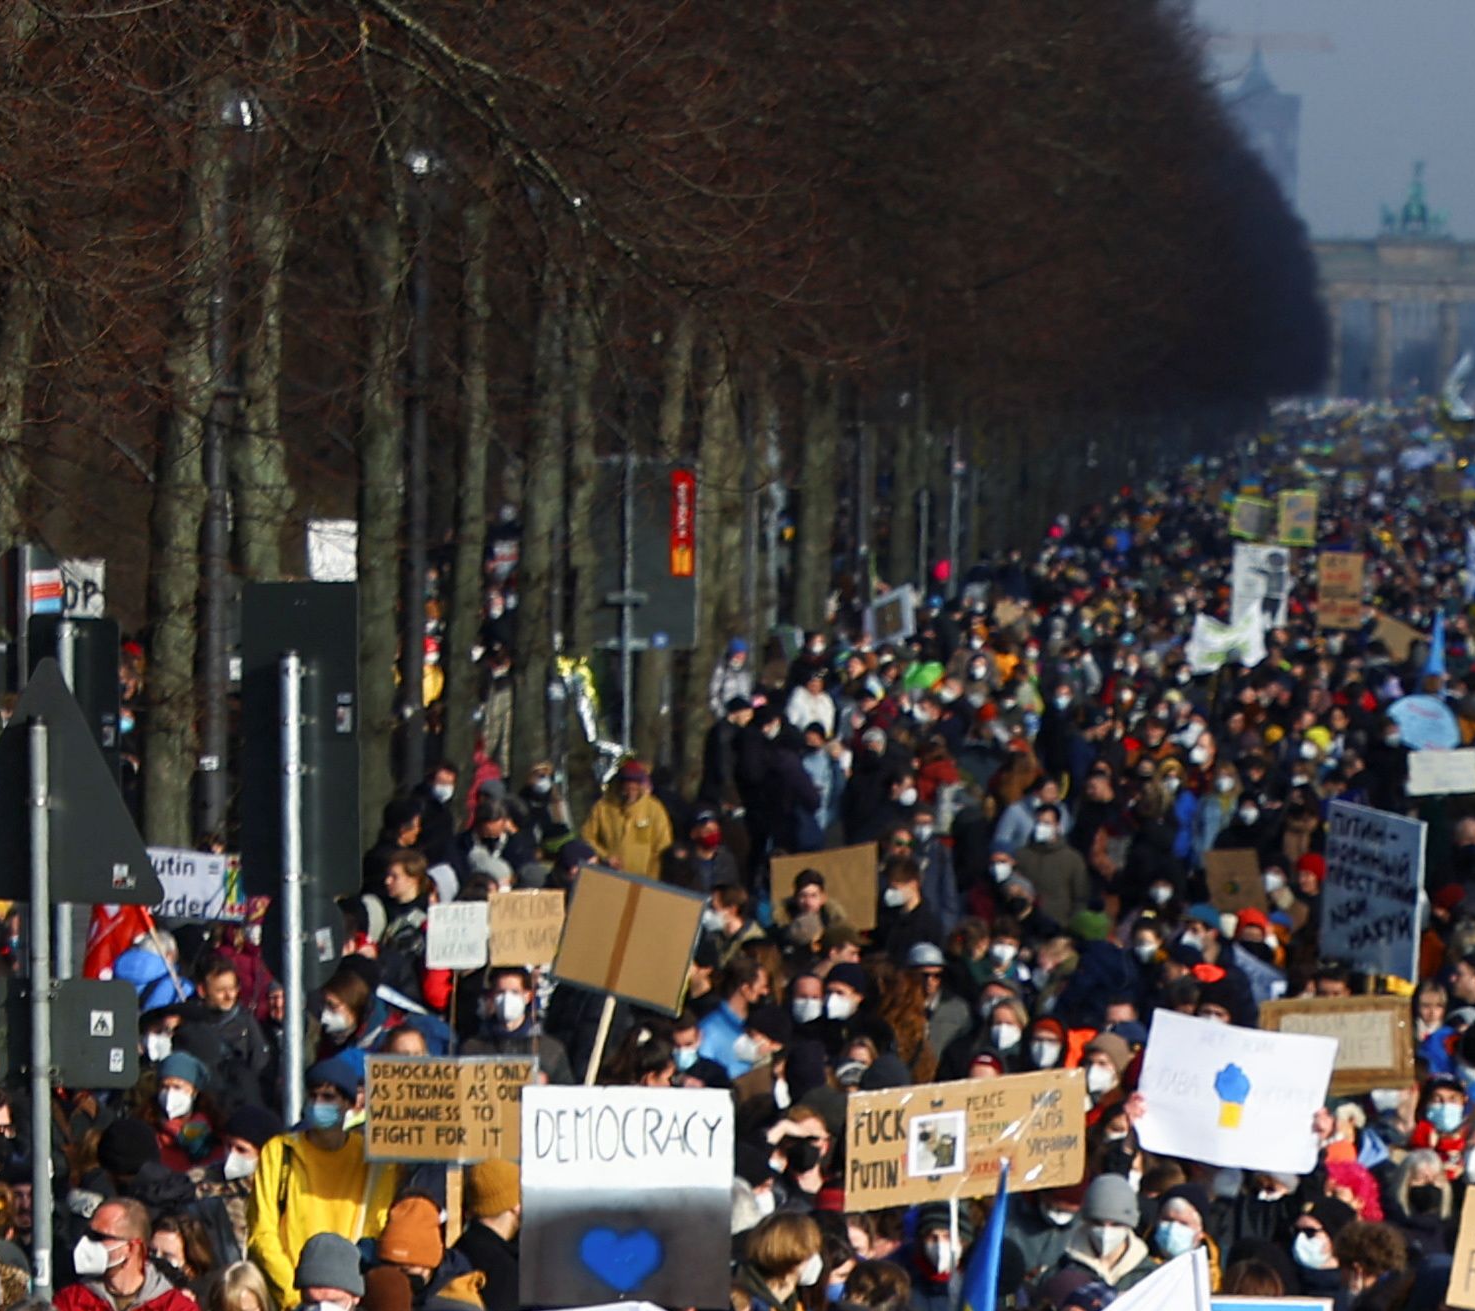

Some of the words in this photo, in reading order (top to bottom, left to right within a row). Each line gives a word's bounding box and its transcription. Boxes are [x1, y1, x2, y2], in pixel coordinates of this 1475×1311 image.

[370, 1063, 463, 1082] DEMOCRACY
[473, 1064, 487, 1081] IS
[493, 1063, 533, 1081] ONLY
[370, 1083, 391, 1101] AS
[395, 1083, 456, 1101] STRONG
[467, 1083, 490, 1101] AS
[370, 1104, 462, 1122] WILLINGNESS
[471, 1104, 495, 1122] TO
[371, 1125, 432, 1145] FIGHT
[434, 1126, 467, 1146] FOR
[481, 1127, 503, 1147] IT
[534, 1105, 723, 1164] DEMOCRACY
[854, 1107, 907, 1148] FUCK
